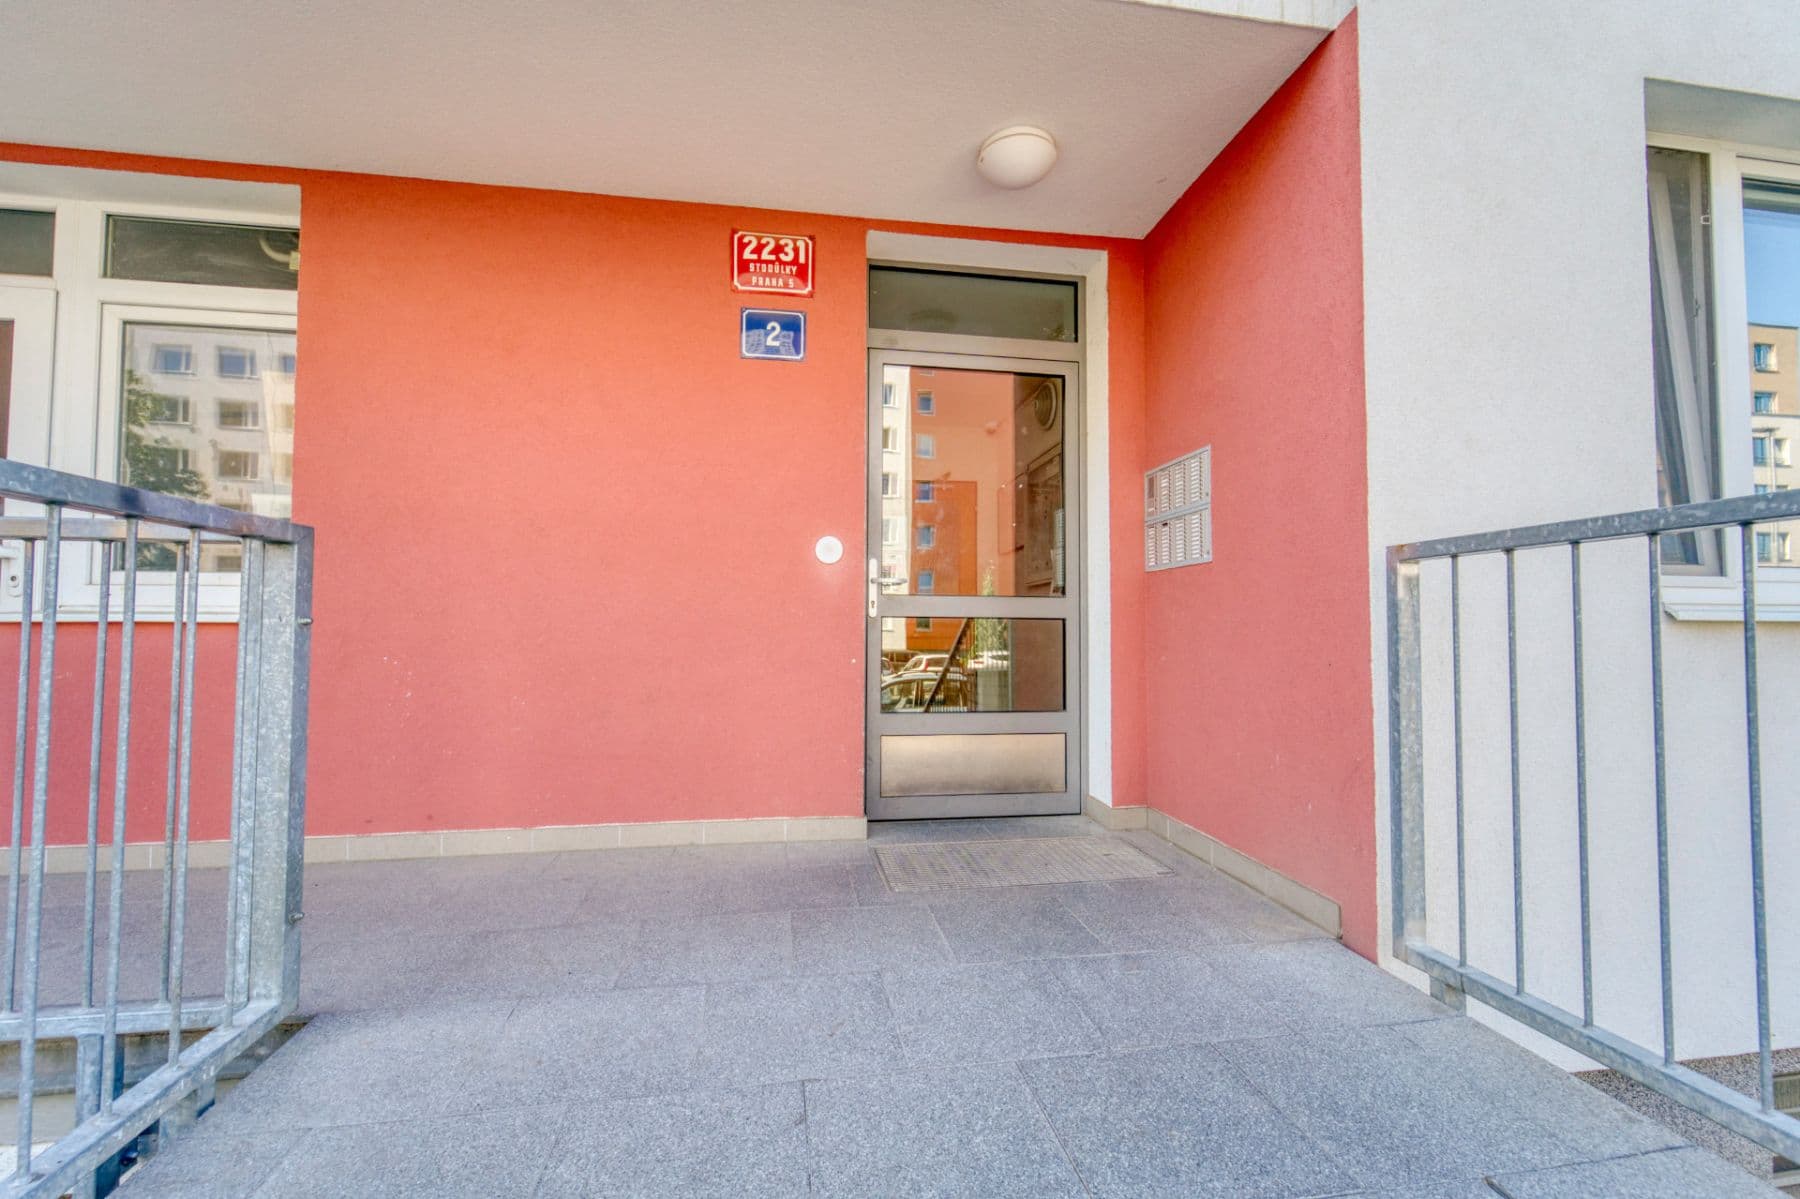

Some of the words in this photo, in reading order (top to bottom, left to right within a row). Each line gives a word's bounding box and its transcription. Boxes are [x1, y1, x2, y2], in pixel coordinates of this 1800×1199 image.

[742, 235, 806, 264] 2231
[751, 276, 784, 288] PRAHA
[787, 278, 795, 288] 5
[766, 321, 781, 346] 2
